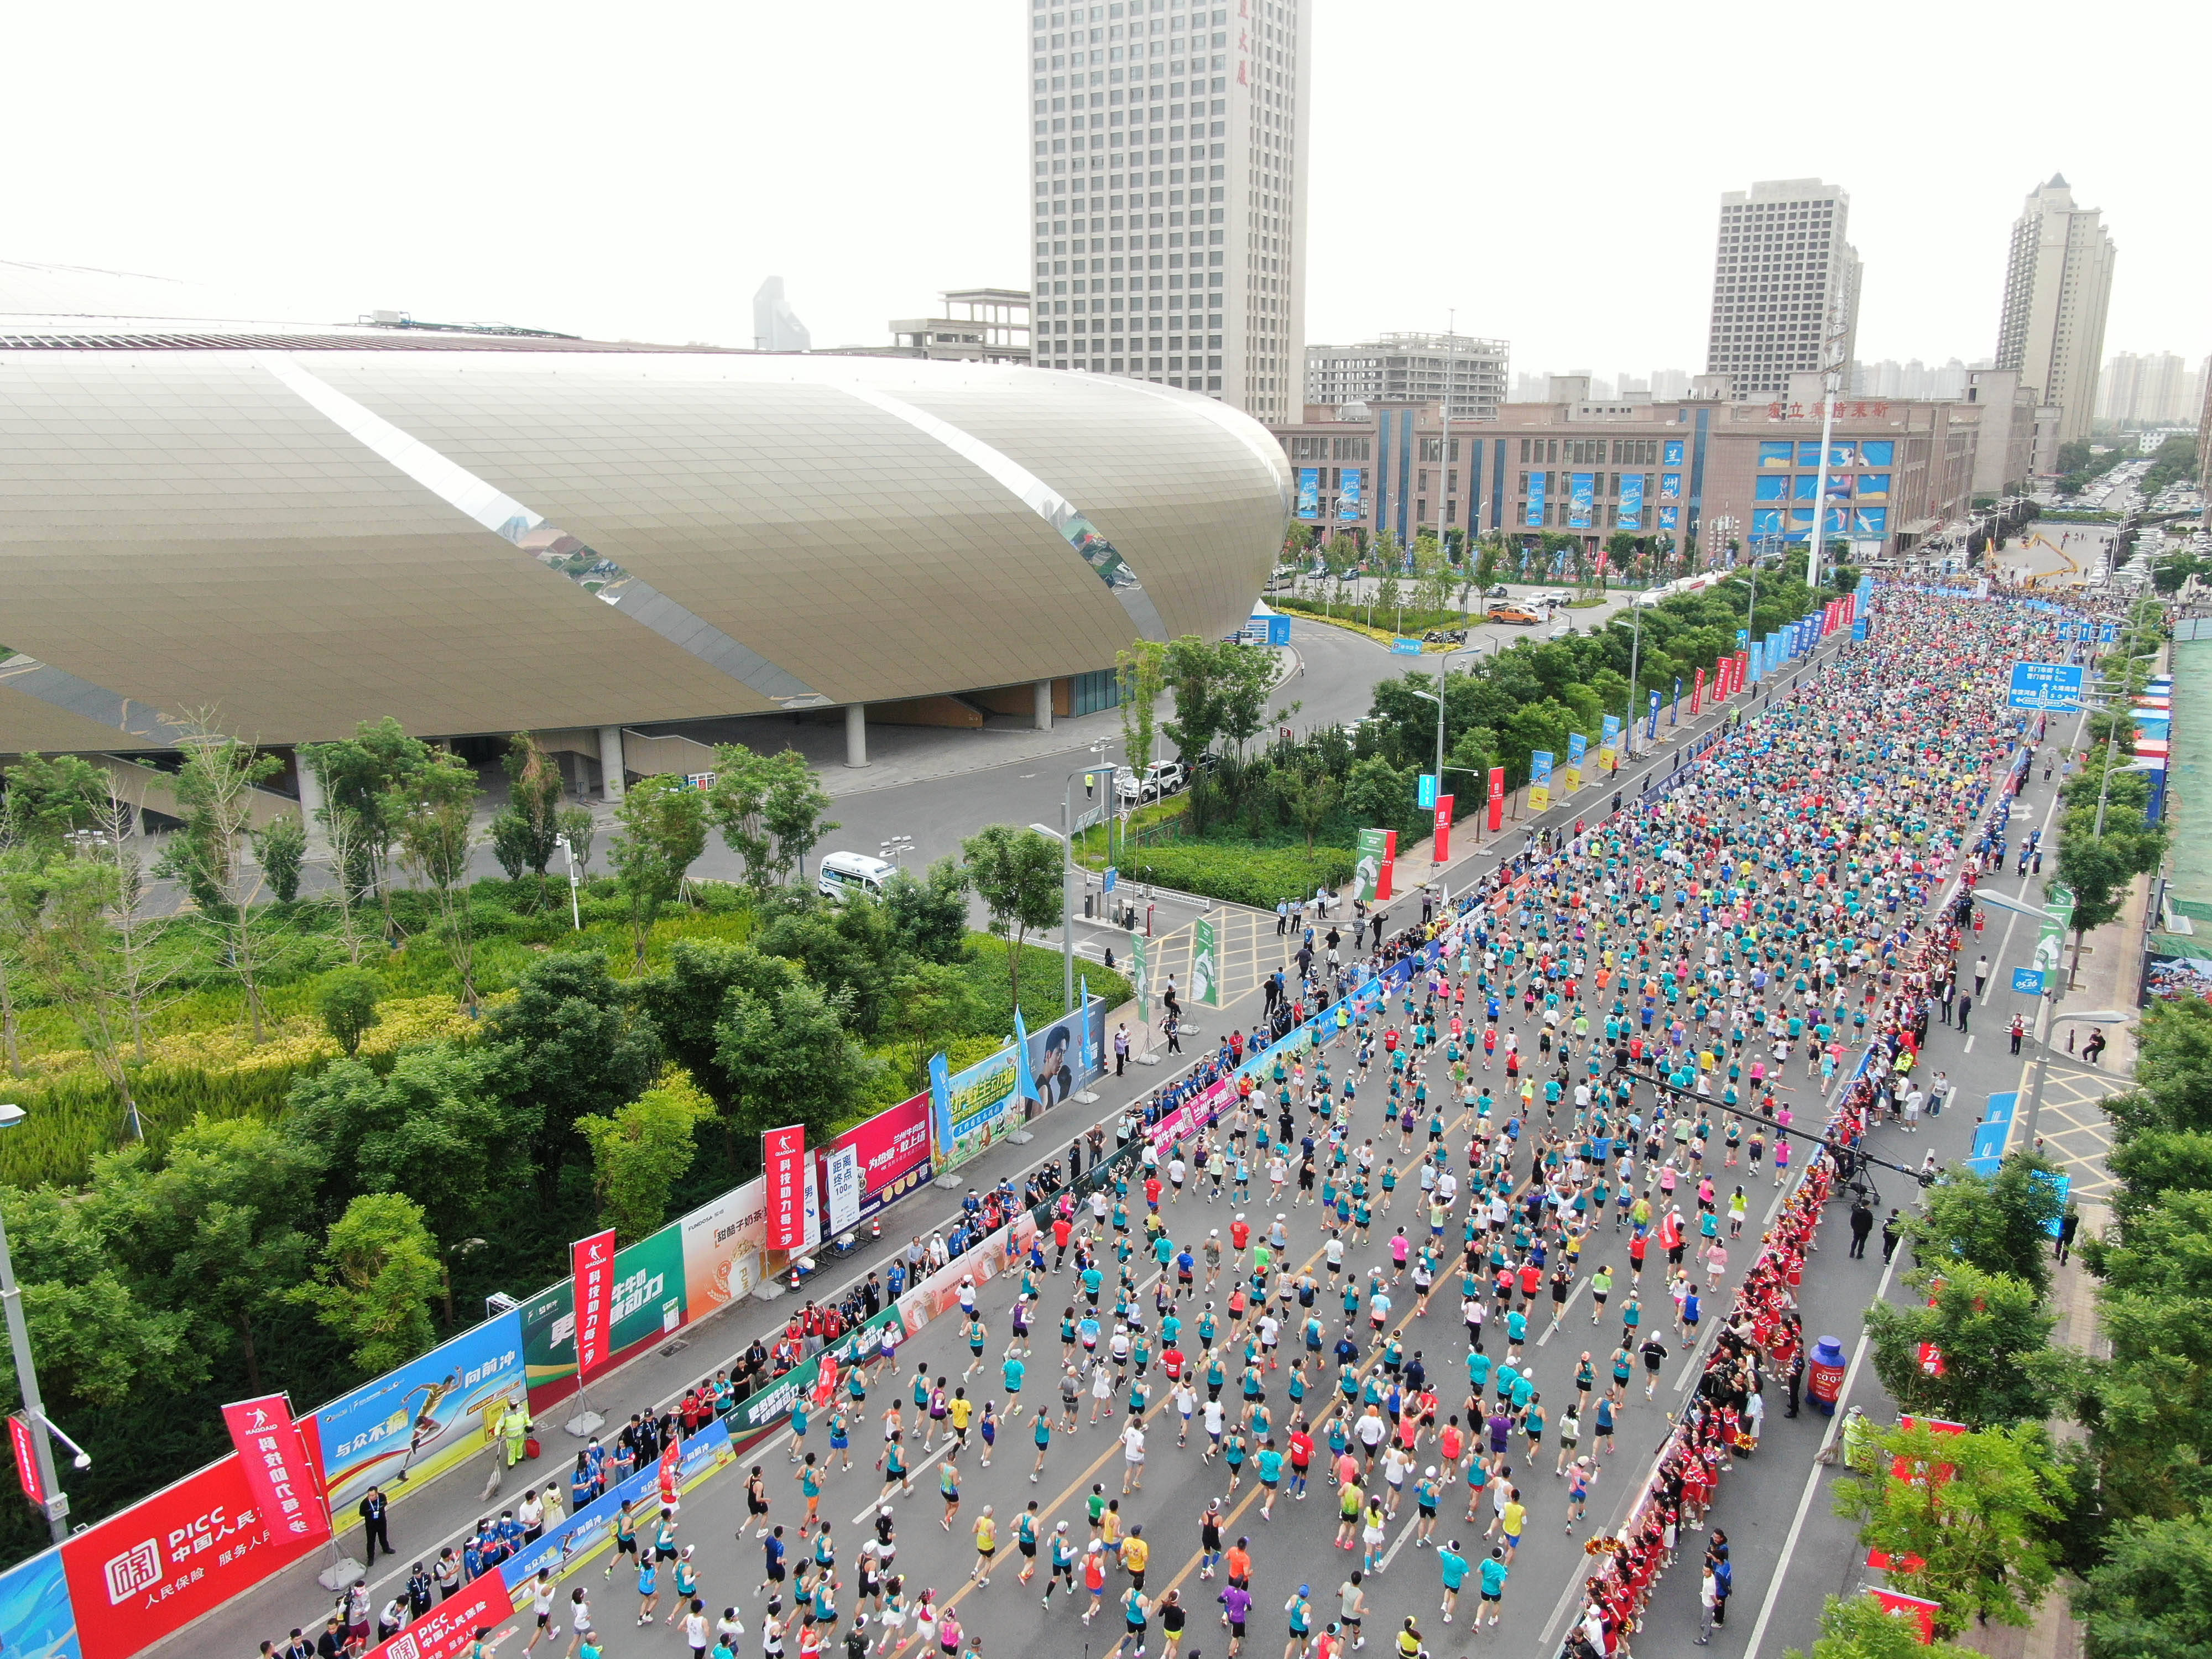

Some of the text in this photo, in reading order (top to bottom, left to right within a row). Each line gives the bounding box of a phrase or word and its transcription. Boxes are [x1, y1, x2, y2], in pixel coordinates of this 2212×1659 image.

[775, 1149, 796, 1157] QIAODAN
[833, 1154, 852, 1174] 距离
[833, 1168, 852, 1188] 终点
[836, 1183, 852, 1196] 100m
[780, 1159, 793, 1245] 科技助力每一步
[688, 1215, 713, 1232] FUNDOSA
[585, 1257, 607, 1269] QIAODAN
[583, 1269, 601, 1366] 科技助力每一步
[465, 1350, 516, 1389] 向前冲
[168, 1505, 225, 1548] PICC
[172, 1507, 263, 1563] 中国人民
[145, 1567, 205, 1609] 人民保险
[418, 1612, 448, 1640] PICC
[422, 1601, 487, 1648] 中国人民保险
